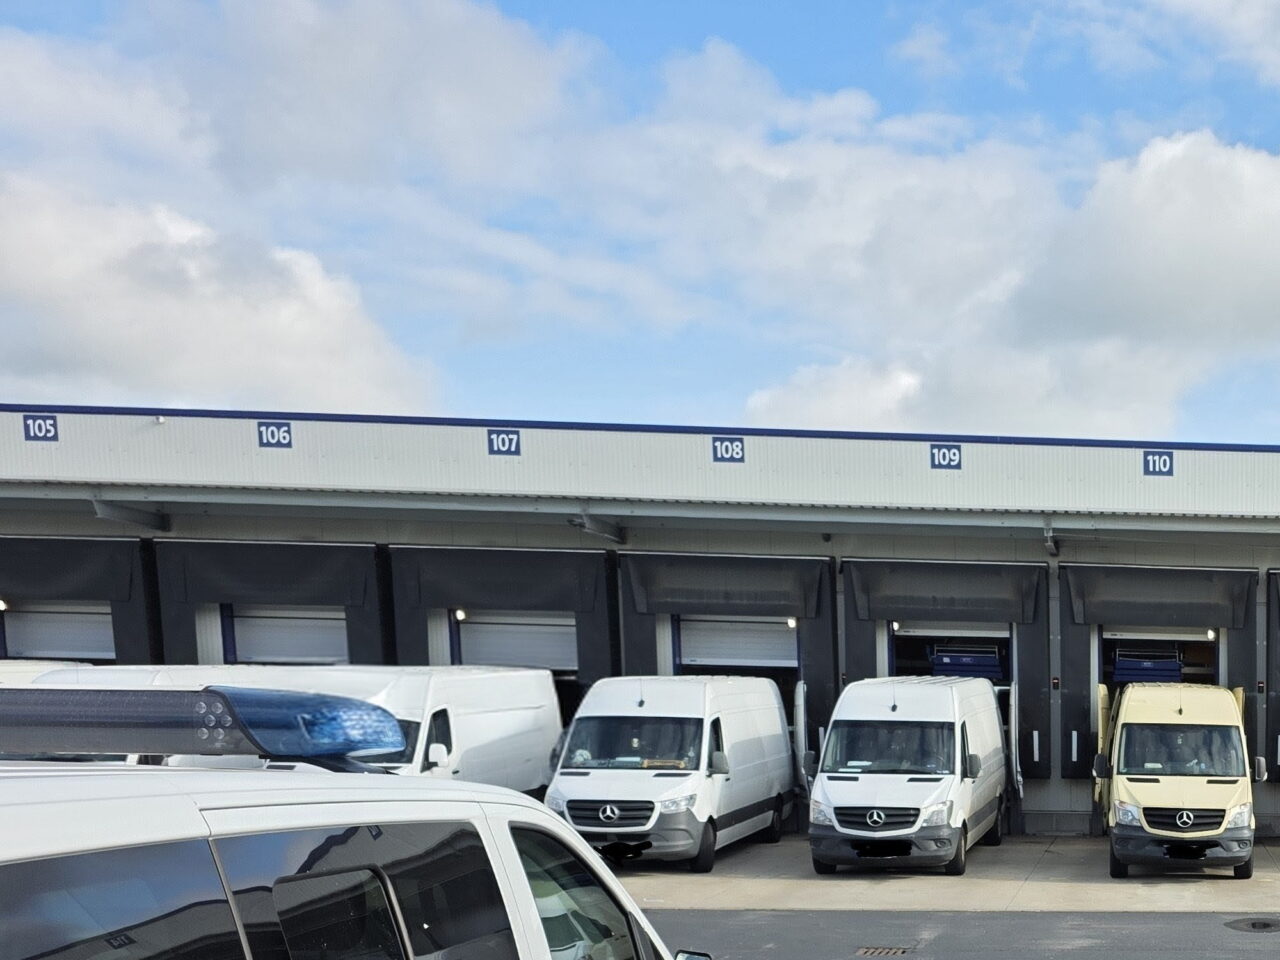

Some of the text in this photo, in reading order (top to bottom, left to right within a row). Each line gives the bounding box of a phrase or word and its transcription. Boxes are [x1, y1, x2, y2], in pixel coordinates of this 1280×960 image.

[27, 420, 55, 437] 105
[260, 426, 289, 443] 106
[491, 434, 518, 451] 107
[715, 442, 742, 458] 108
[932, 449, 959, 465] 109
[1146, 455, 1170, 471] 110
